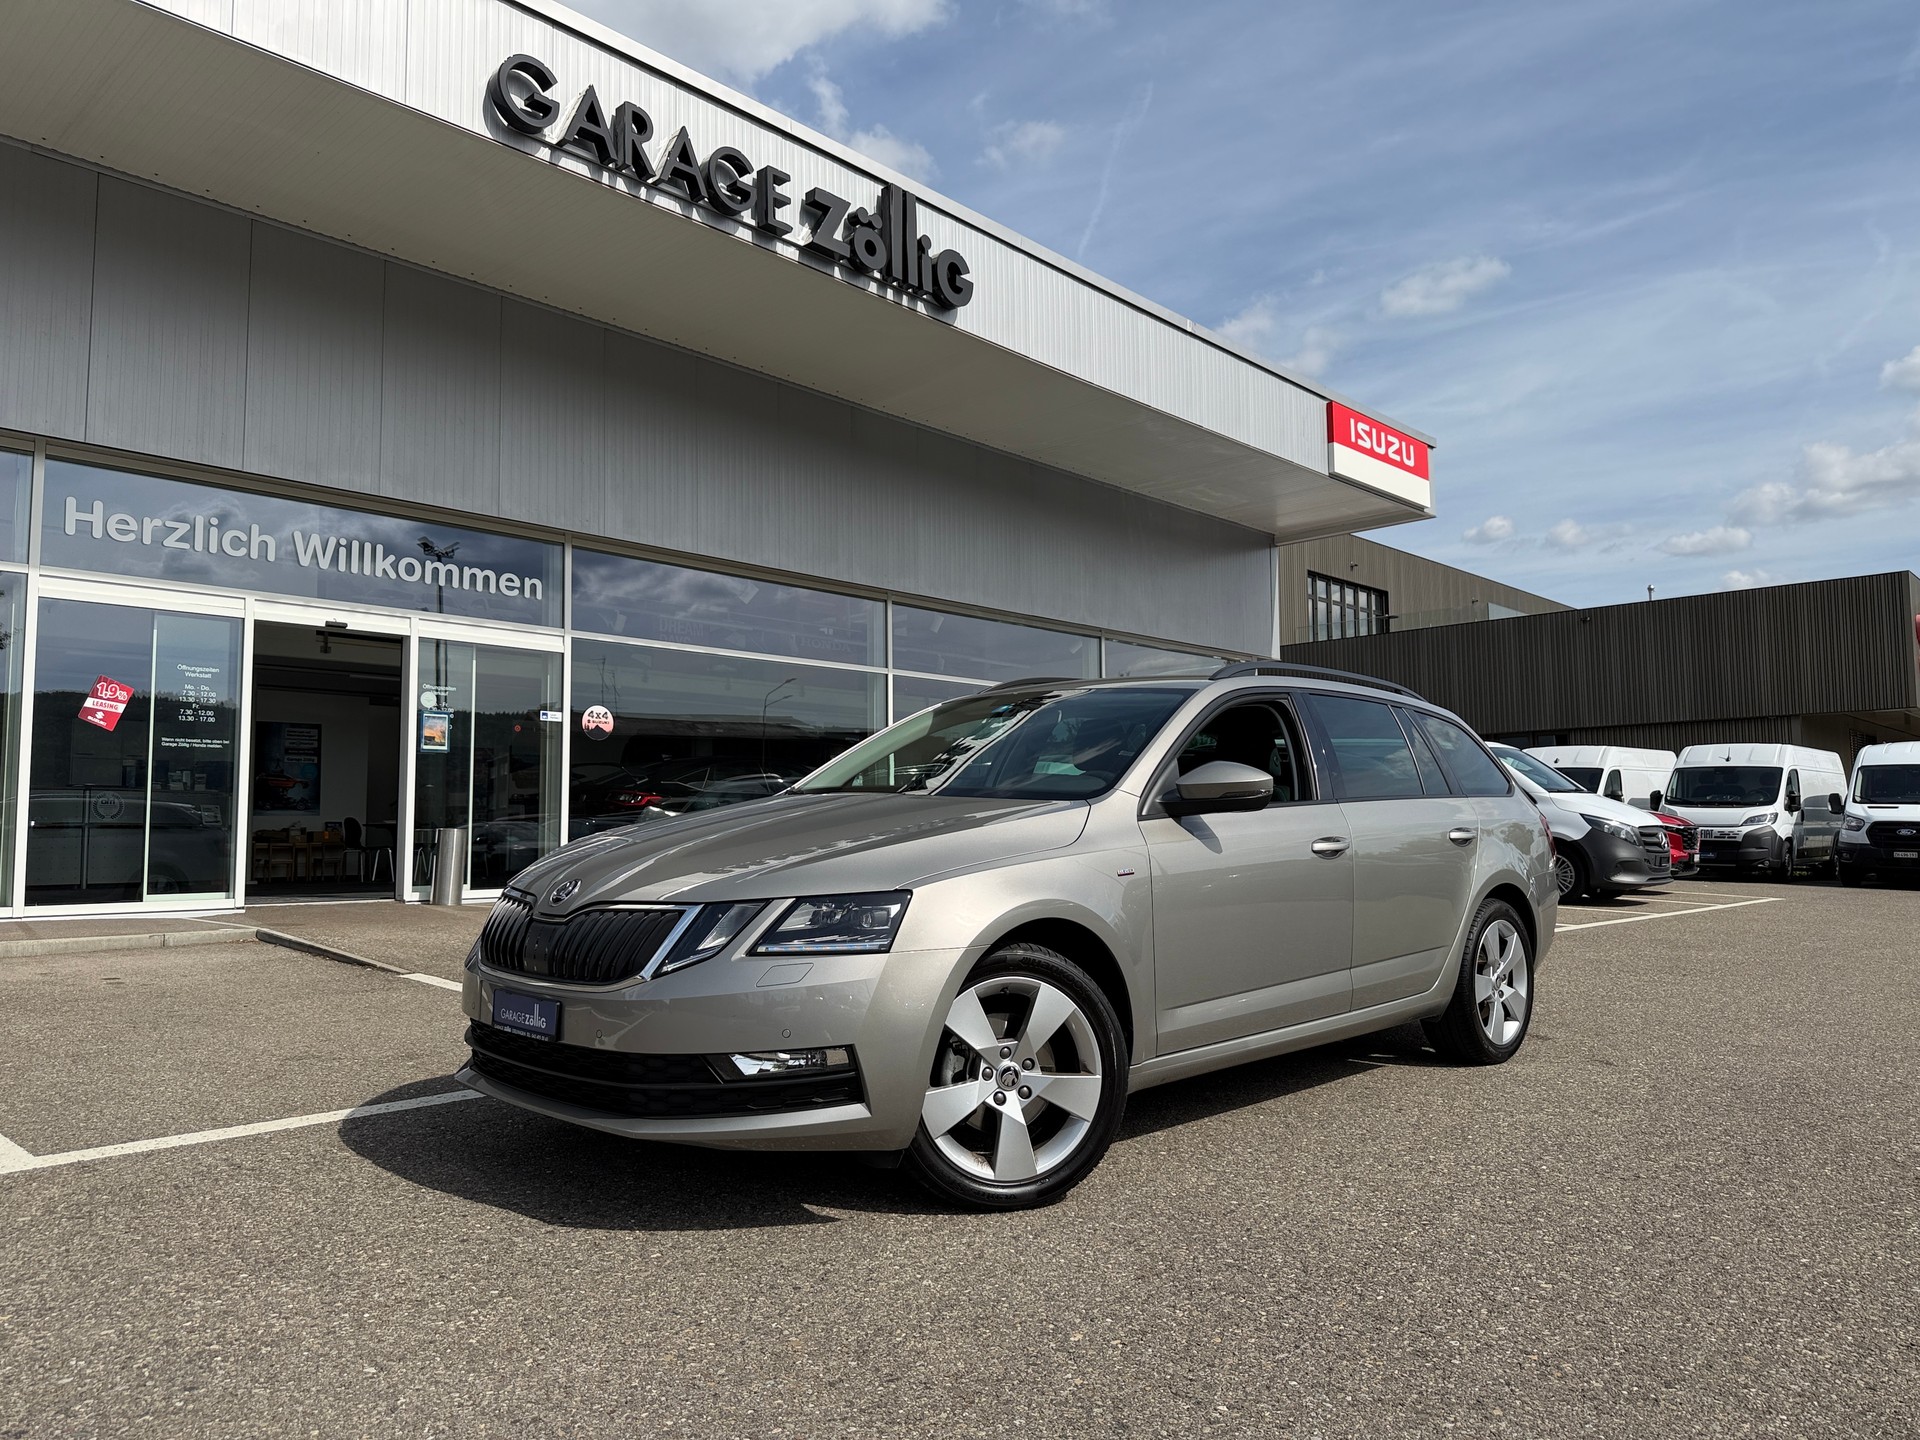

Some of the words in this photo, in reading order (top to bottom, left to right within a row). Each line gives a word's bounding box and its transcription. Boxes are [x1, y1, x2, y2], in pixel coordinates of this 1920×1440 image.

[488, 53, 794, 236] GARAGE
[1350, 417, 1415, 468] ISUZU
[64, 496, 276, 562] Herzlich
[293, 530, 543, 600] Willkommen
[177, 664, 219, 672] Öffnungszeiten
[92, 700, 119, 710] LEASING
[588, 710, 609, 720] 4x4
[1700, 829, 1714, 839] FIAT
[500, 1008, 526, 1024] GARAGE
